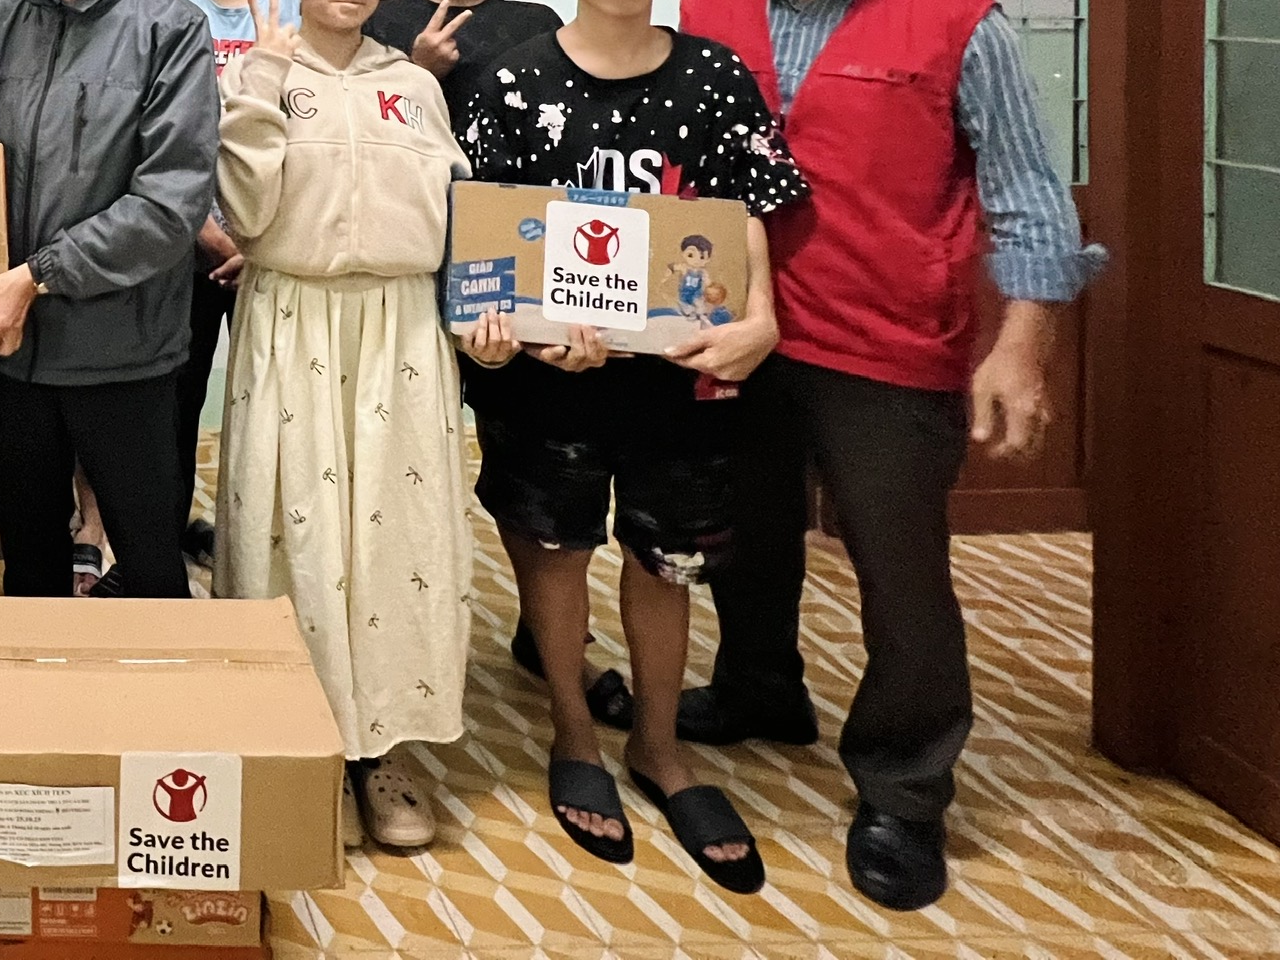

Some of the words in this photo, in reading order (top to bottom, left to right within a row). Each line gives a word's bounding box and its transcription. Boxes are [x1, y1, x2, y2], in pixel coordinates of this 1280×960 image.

[461, 277, 501, 296] CANXI
[552, 266, 600, 287] Save
[605, 272, 639, 292] the
[550, 287, 639, 314] Children
[129, 827, 185, 850] Save
[191, 829, 230, 852] the
[127, 853, 230, 879] Children
